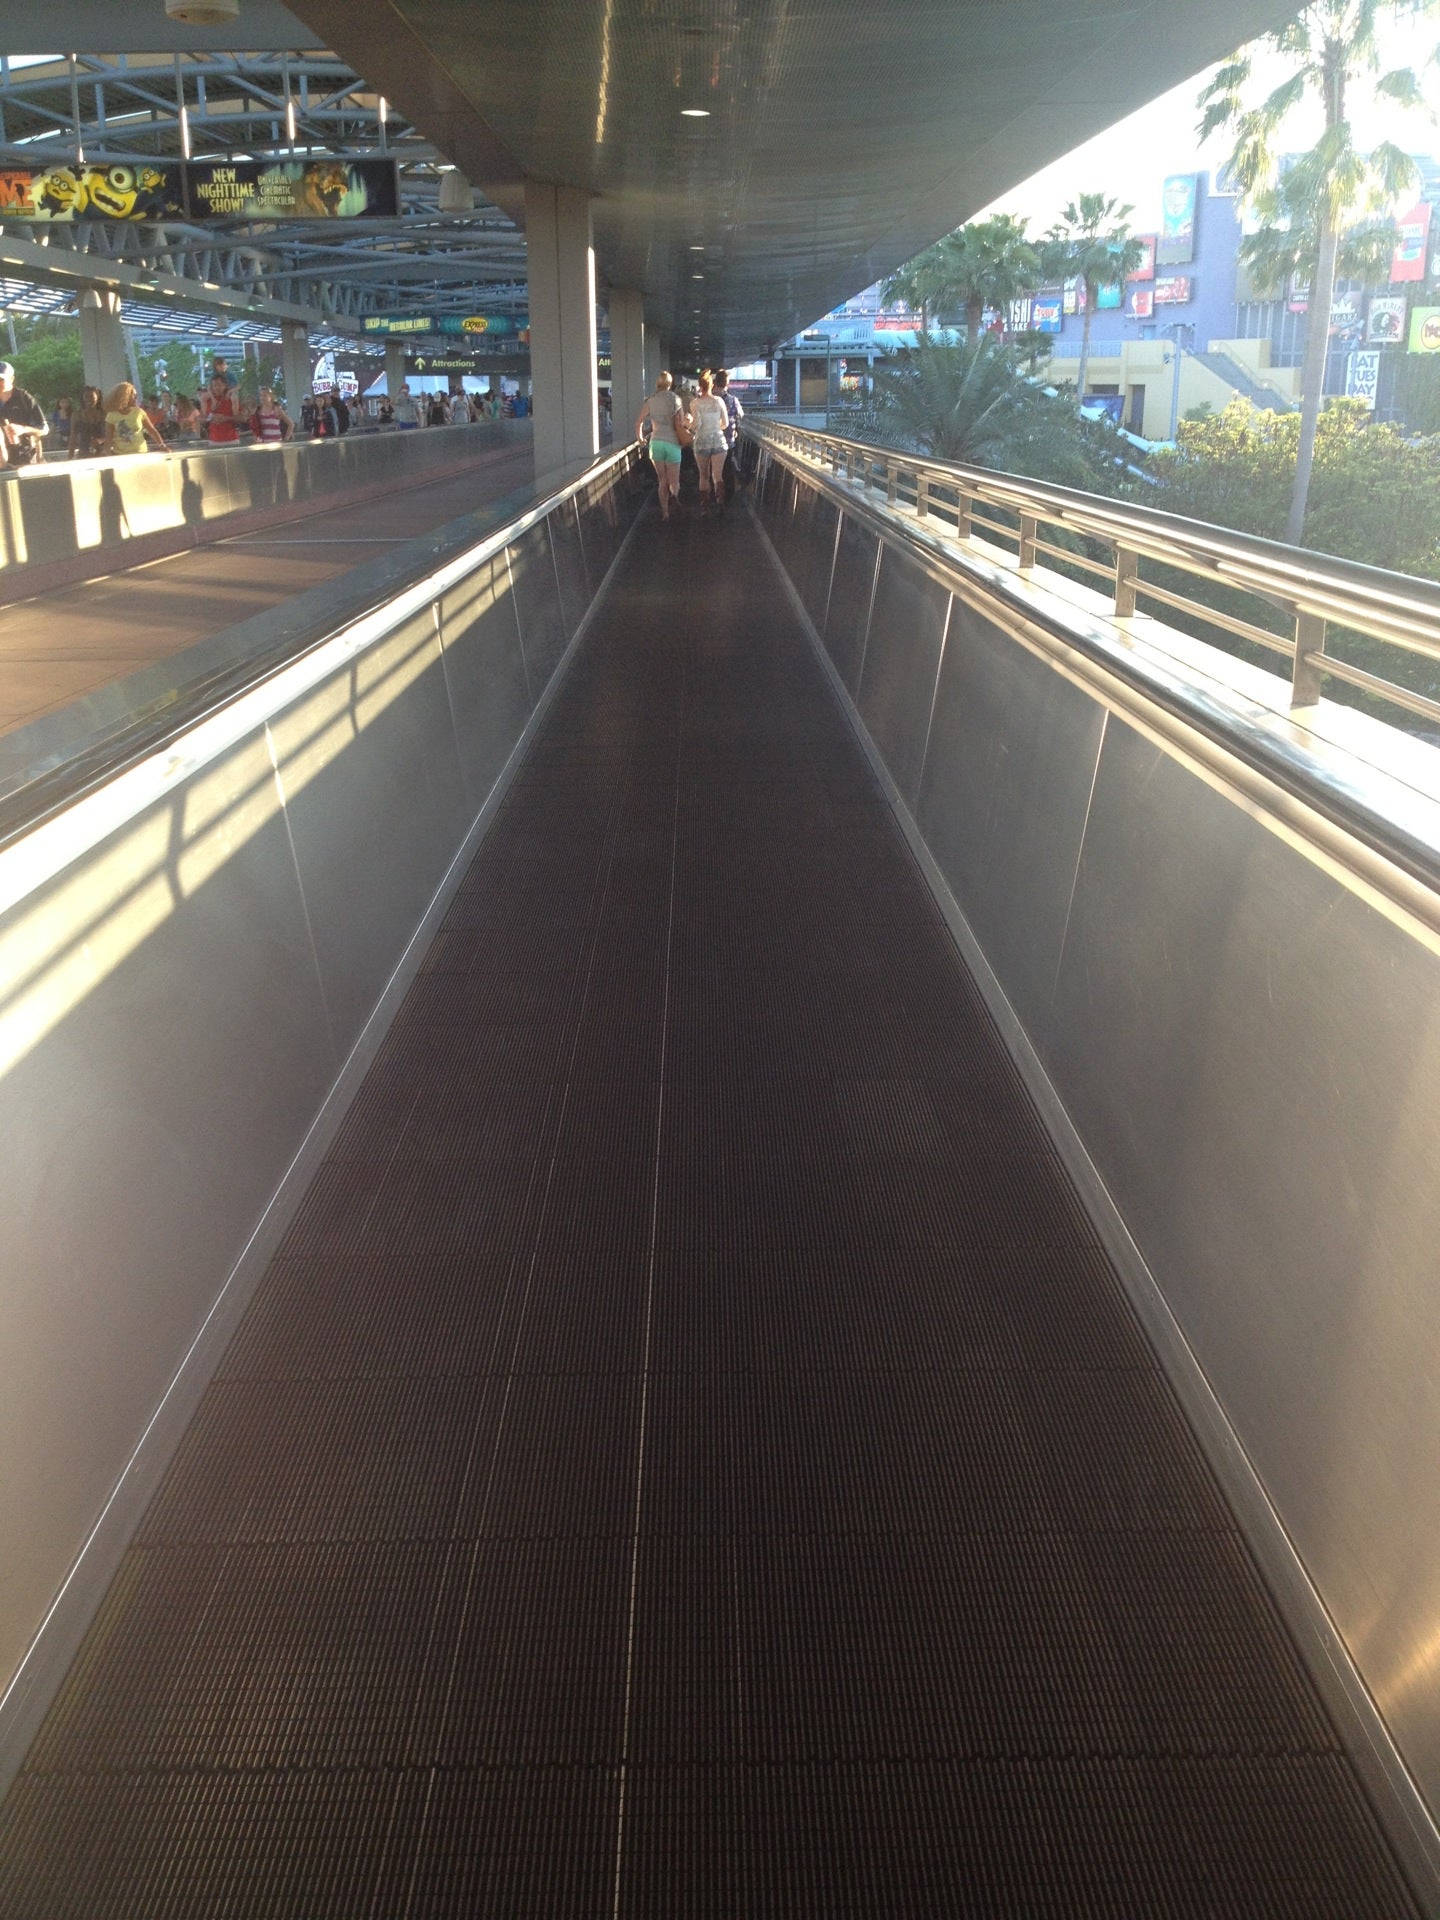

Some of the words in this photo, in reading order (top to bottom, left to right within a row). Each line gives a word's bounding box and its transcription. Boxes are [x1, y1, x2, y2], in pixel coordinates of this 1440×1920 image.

[212, 168, 236, 184] NEW
[196, 183, 255, 198] NIGHTTIME
[260, 186, 291, 196] CINEMATIC
[209, 198, 245, 213] SHOW!
[257, 195, 296, 206] SPECTACULAR
[431, 359, 476, 368] Attractions
[337, 380, 358, 393] GUMP
